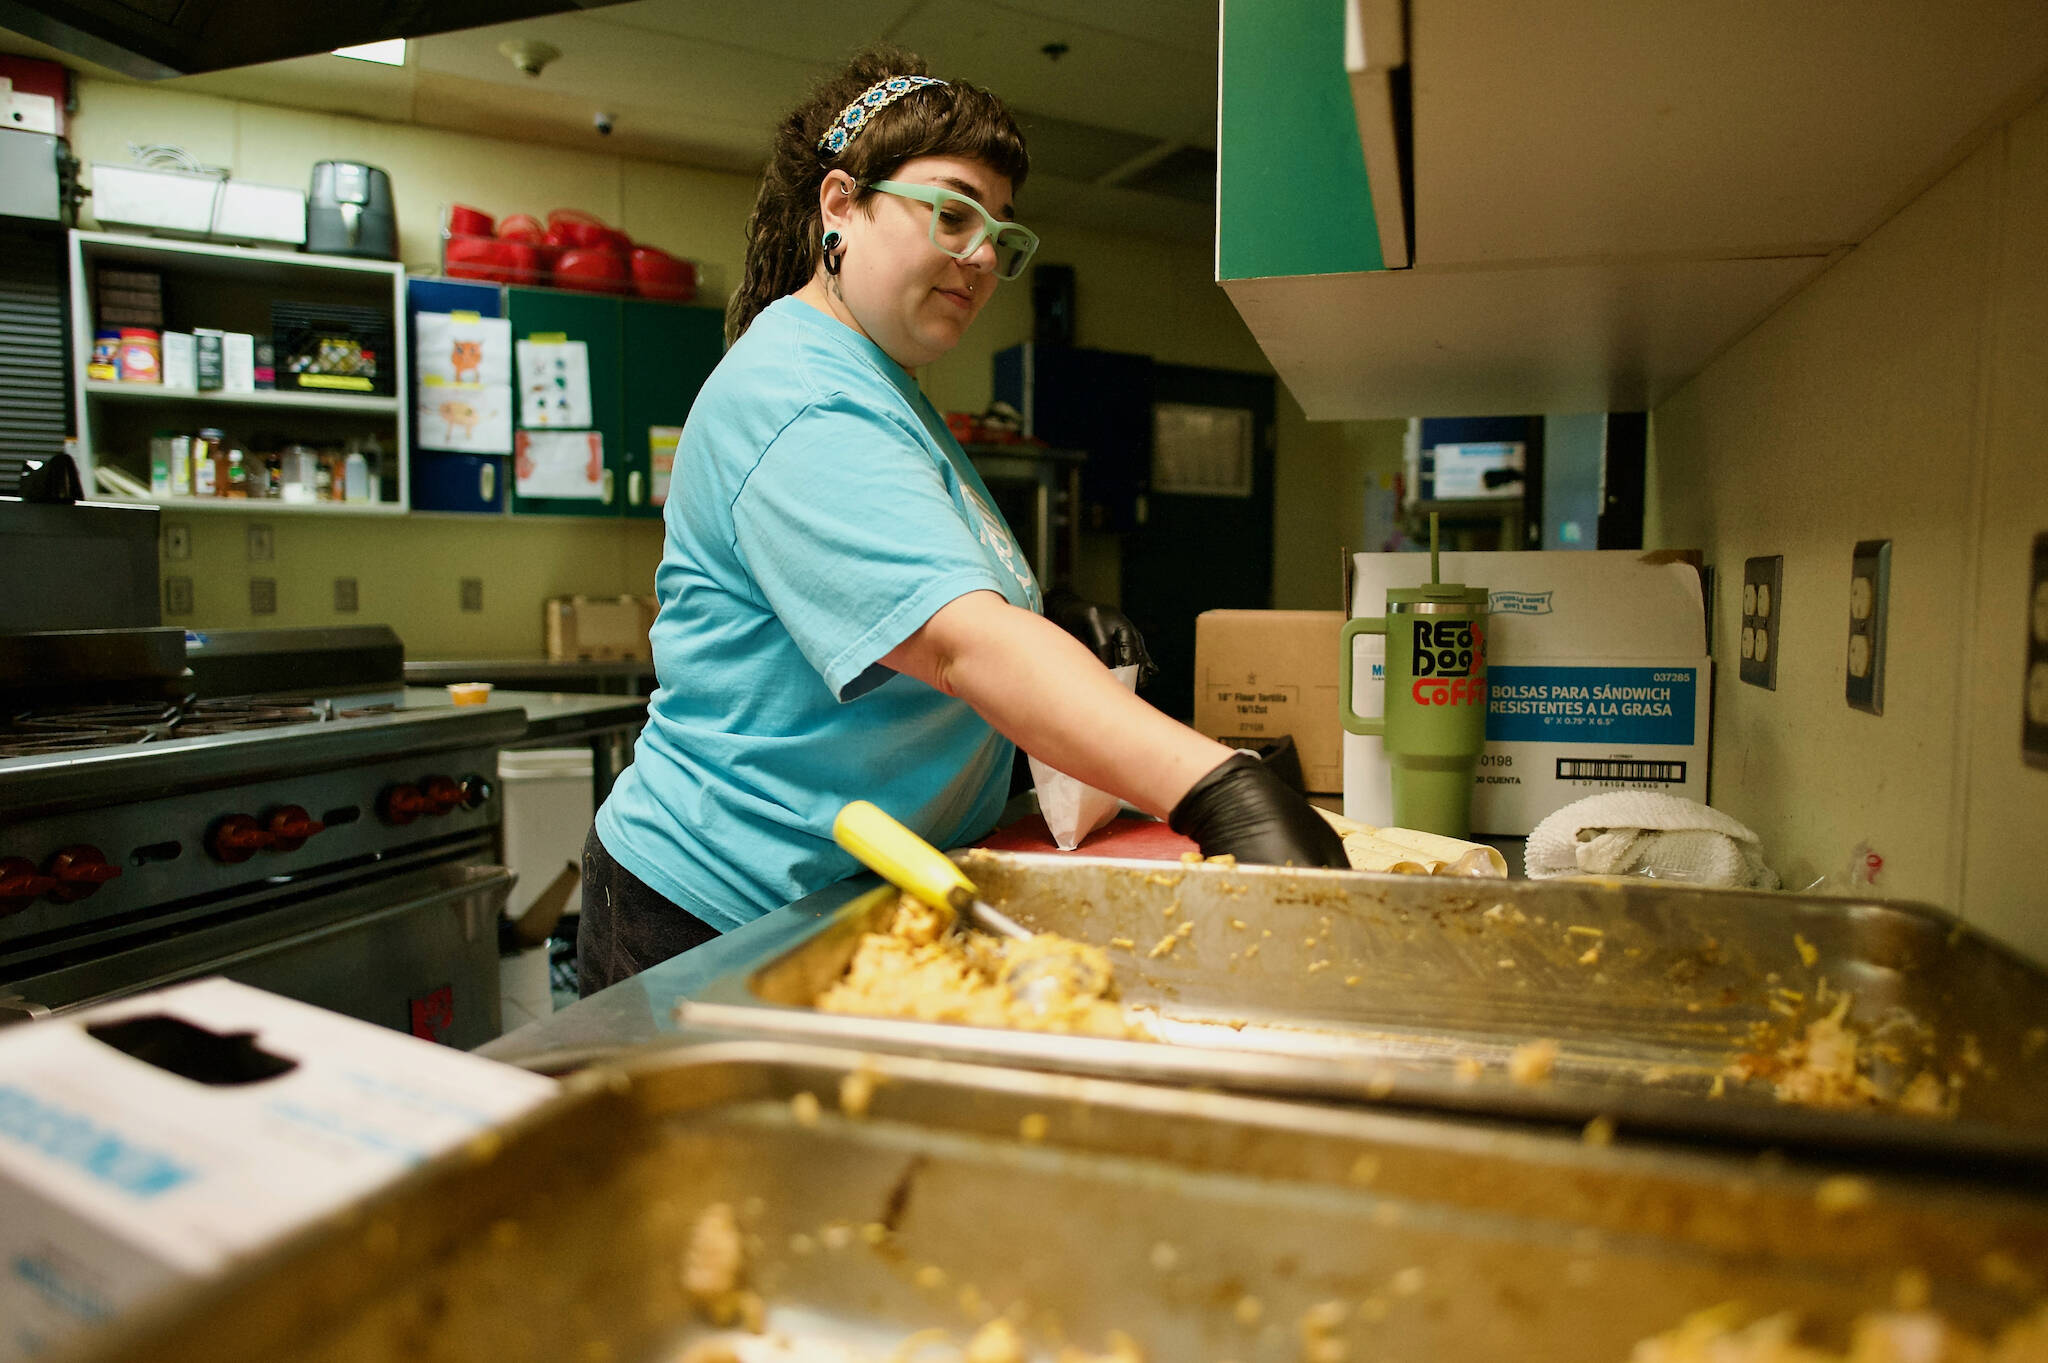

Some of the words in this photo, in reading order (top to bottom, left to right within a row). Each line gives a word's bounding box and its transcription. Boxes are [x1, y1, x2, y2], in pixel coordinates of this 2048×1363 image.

[1653, 672, 1690, 682] 037285
[1491, 685, 1548, 699] BOLSAS
[1551, 686, 1589, 699] PARA
[1592, 683, 1671, 701] SÁNDWICH
[1490, 701, 1583, 715] RESISTENTES
[1586, 703, 1597, 715] A
[1600, 703, 1617, 716] LA
[1621, 703, 1673, 717] GRASA
[1486, 776, 1521, 784] CUENTA
